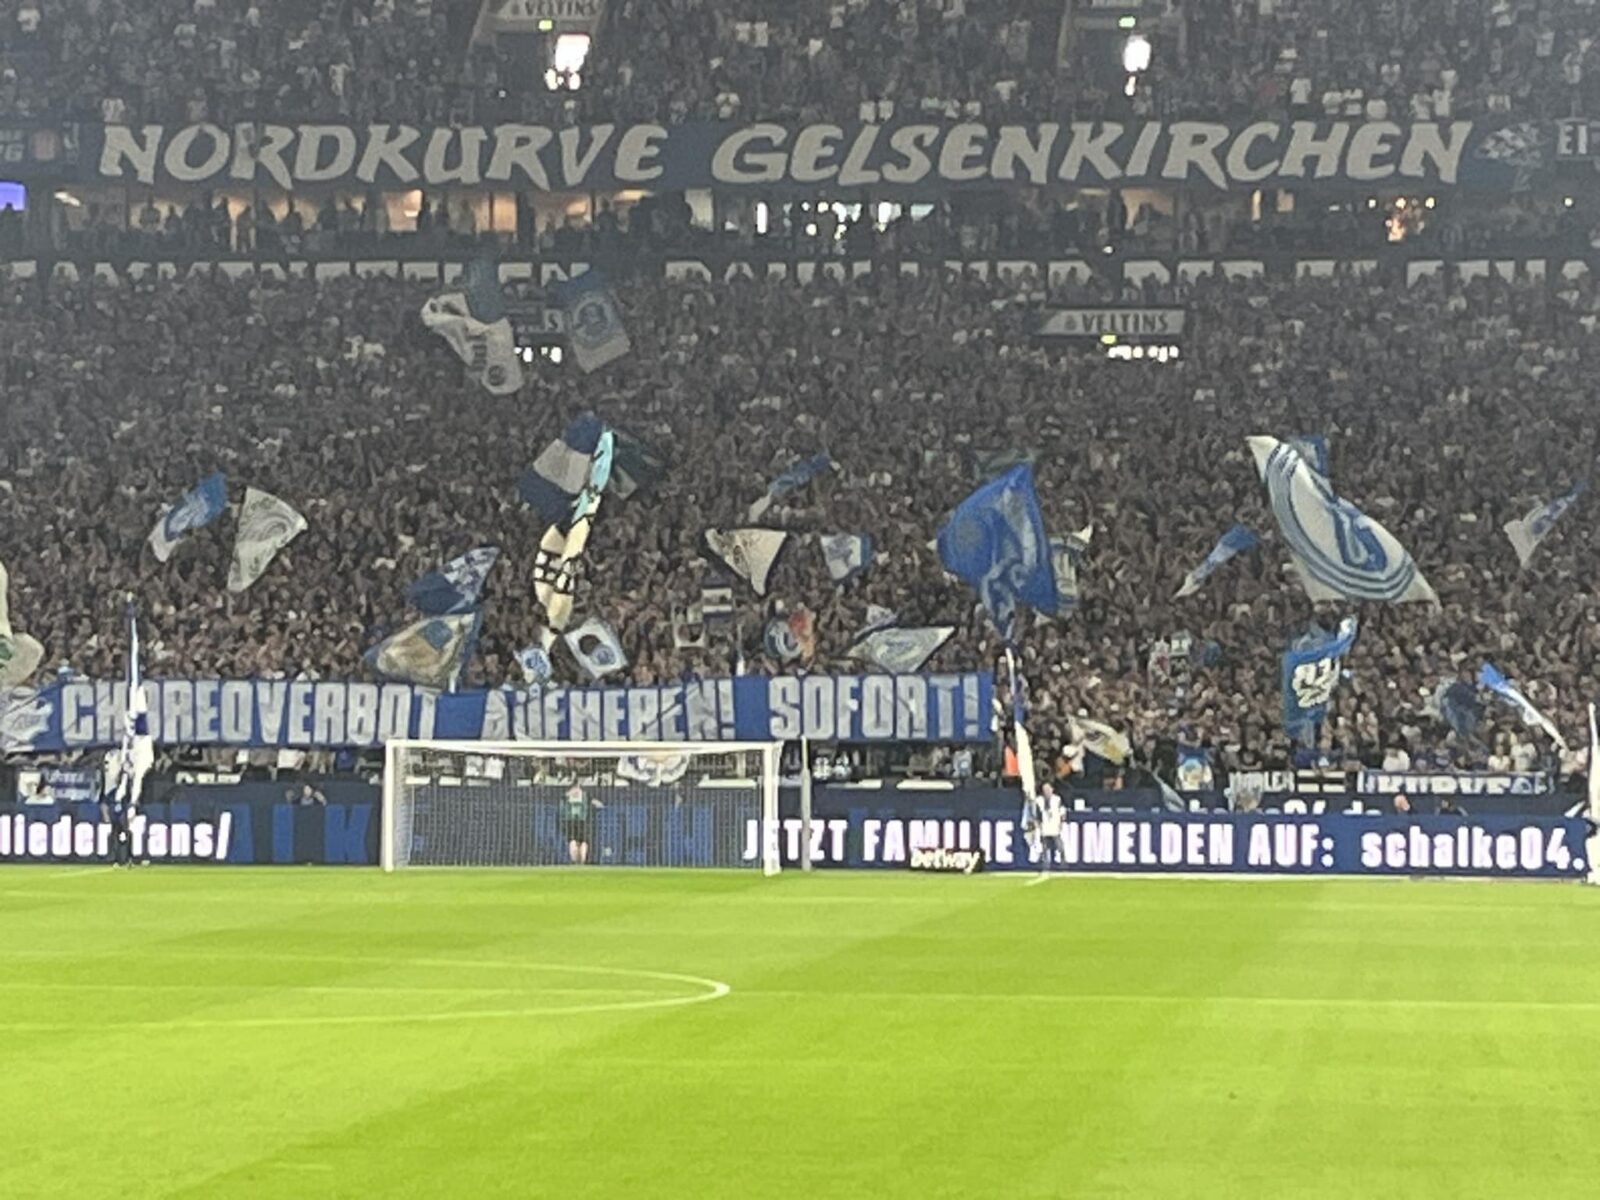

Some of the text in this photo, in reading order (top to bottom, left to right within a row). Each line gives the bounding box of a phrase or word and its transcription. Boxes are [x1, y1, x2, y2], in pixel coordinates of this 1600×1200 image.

[100, 122, 668, 190] NORDKURVE
[711, 120, 1472, 188] GELSENKIRCHEN
[1082, 313, 1168, 332] VELTINS
[481, 680, 735, 741] AUFHEBEN!
[769, 676, 979, 739] SOFORT!
[742, 819, 848, 861] JTZT
[1028, 822, 1233, 865] NMELDEN
[1249, 824, 1335, 867] AUF:
[1361, 826, 1584, 870] schalke04.
[911, 849, 980, 874] betway
